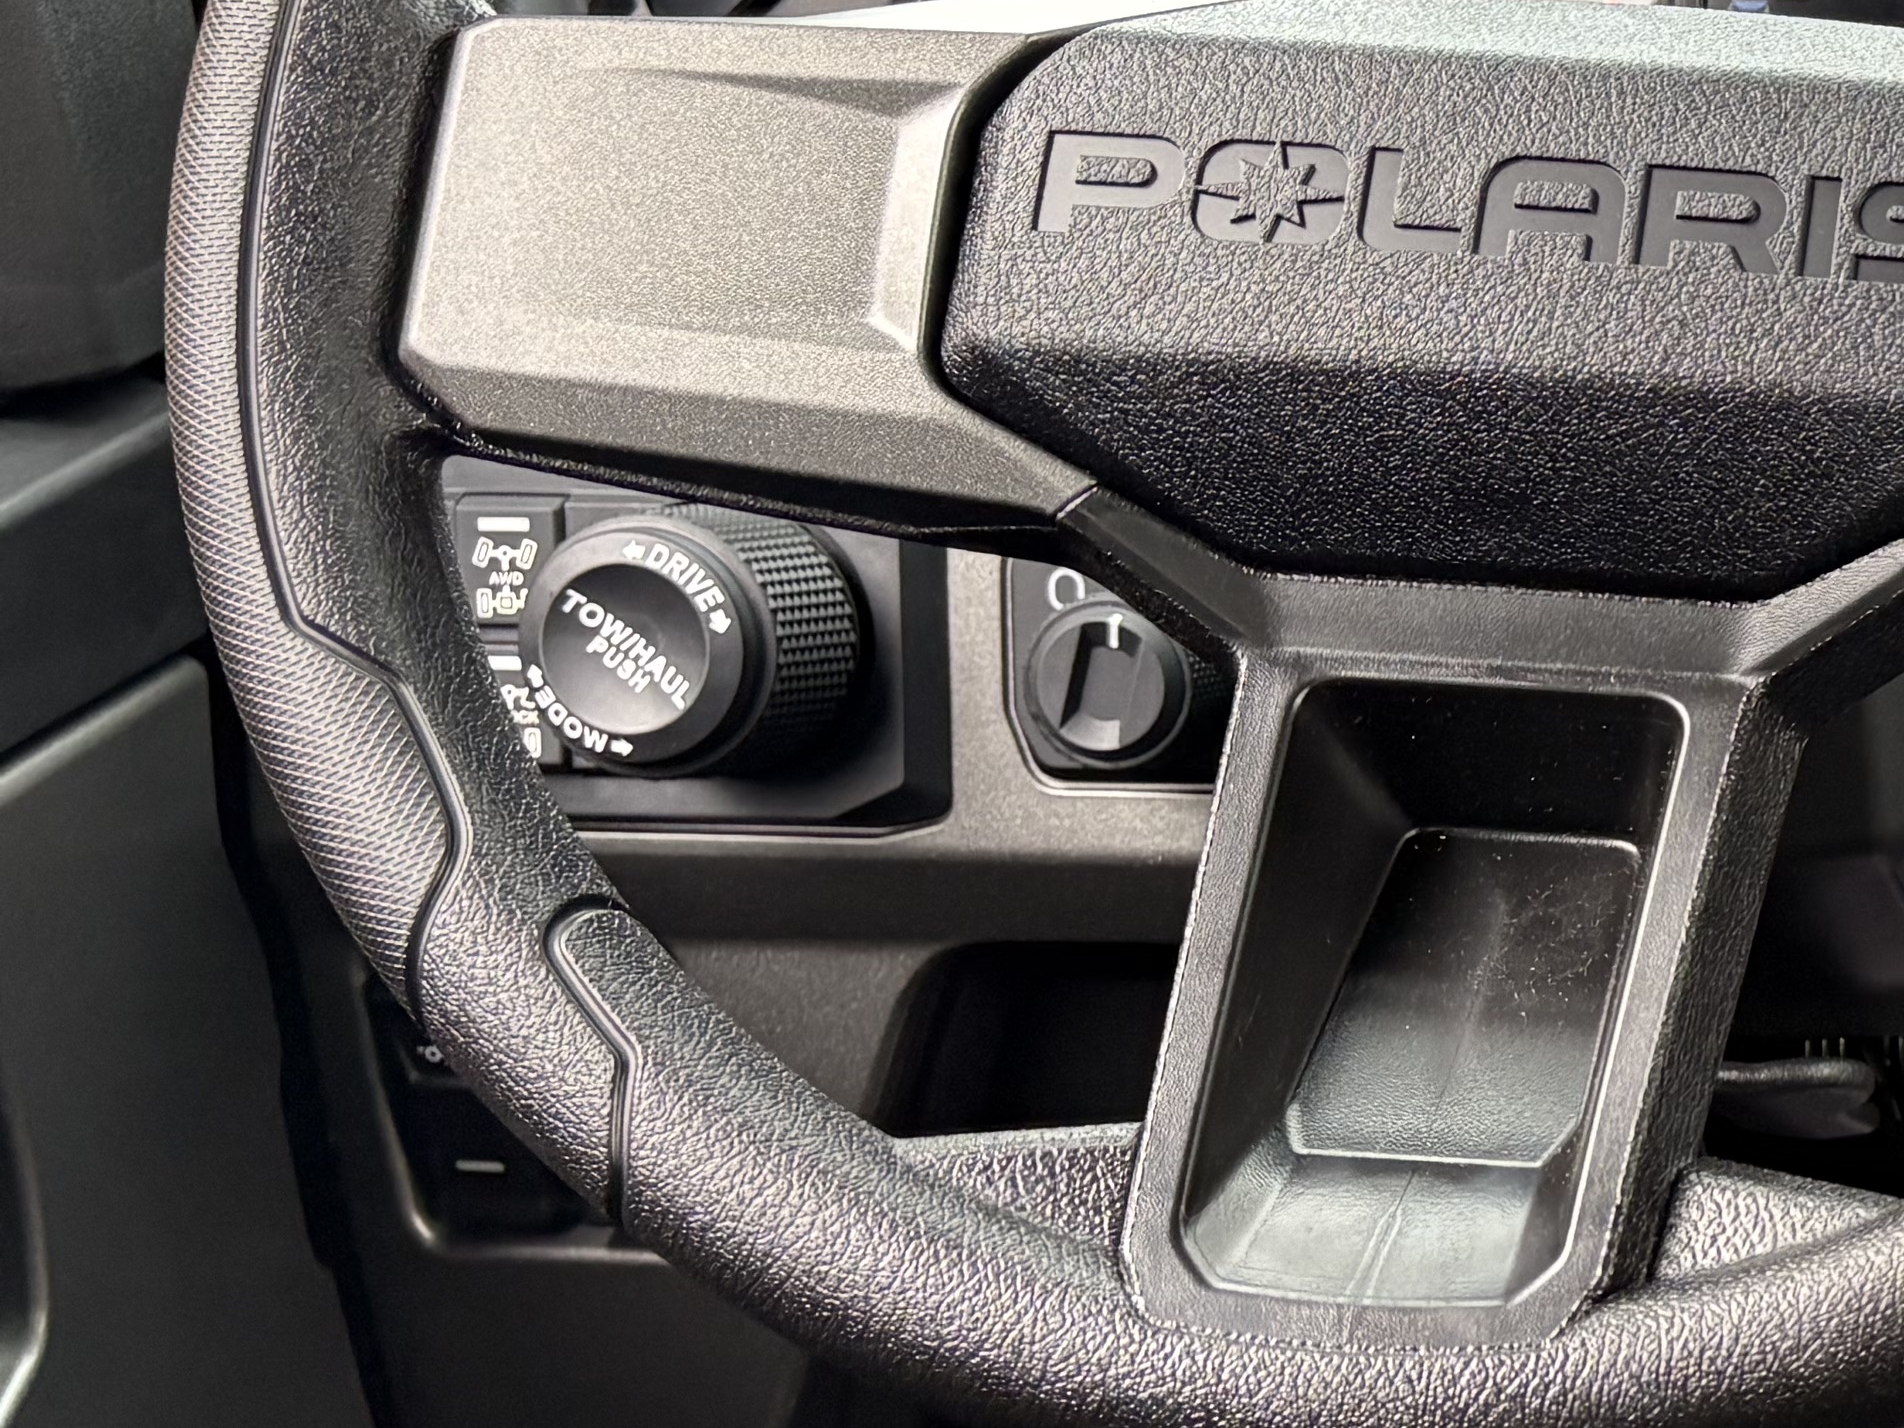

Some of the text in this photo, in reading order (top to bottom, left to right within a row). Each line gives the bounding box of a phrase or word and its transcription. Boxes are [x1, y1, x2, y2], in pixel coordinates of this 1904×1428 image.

[488, 571, 524, 586] AWD
[646, 543, 722, 612] DRIVE
[561, 588, 692, 711] TOW/HAUL
[586, 634, 651, 694] PUSH
[534, 685, 609, 754] MODE
